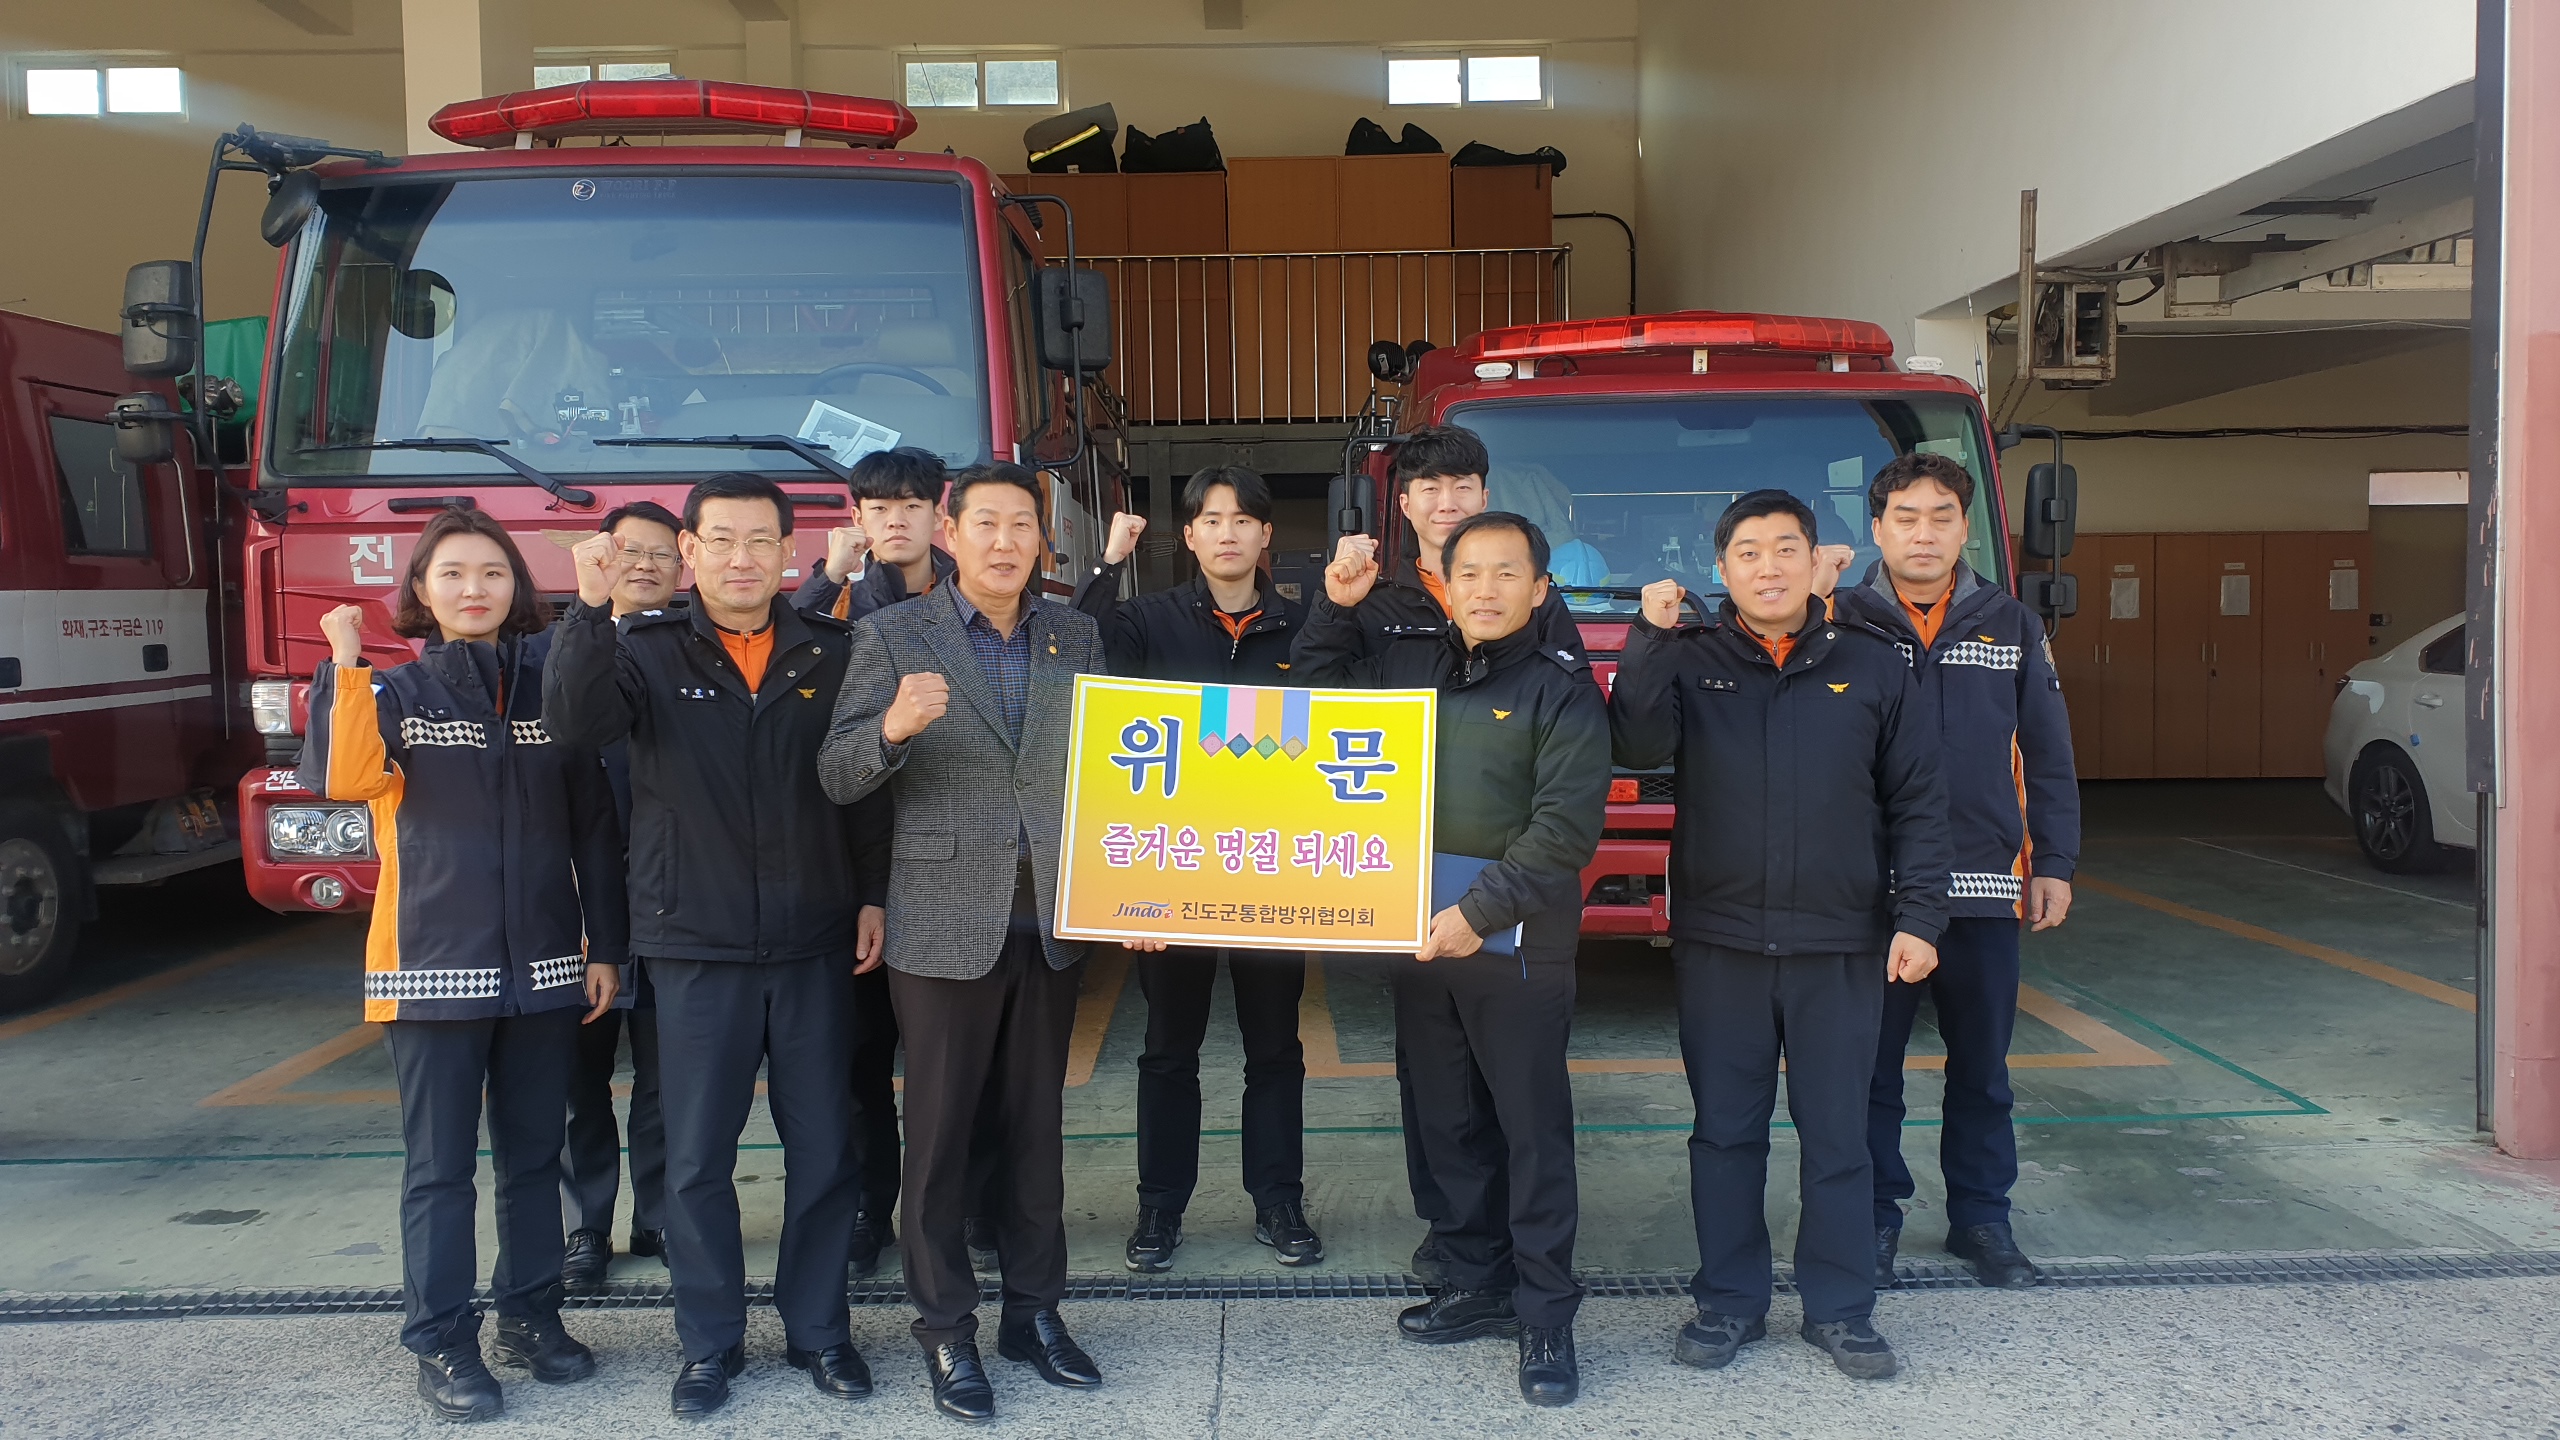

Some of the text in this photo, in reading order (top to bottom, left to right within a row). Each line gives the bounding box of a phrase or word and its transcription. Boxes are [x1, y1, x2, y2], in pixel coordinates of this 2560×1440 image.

[349, 536, 394, 585] 전
[145, 618, 164, 636] 119
[1109, 716, 1396, 801] 위 문
[1101, 824, 1392, 877] 즐거운 명절 되세요
[1180, 901, 1376, 928] 진도군통합방위협의회
